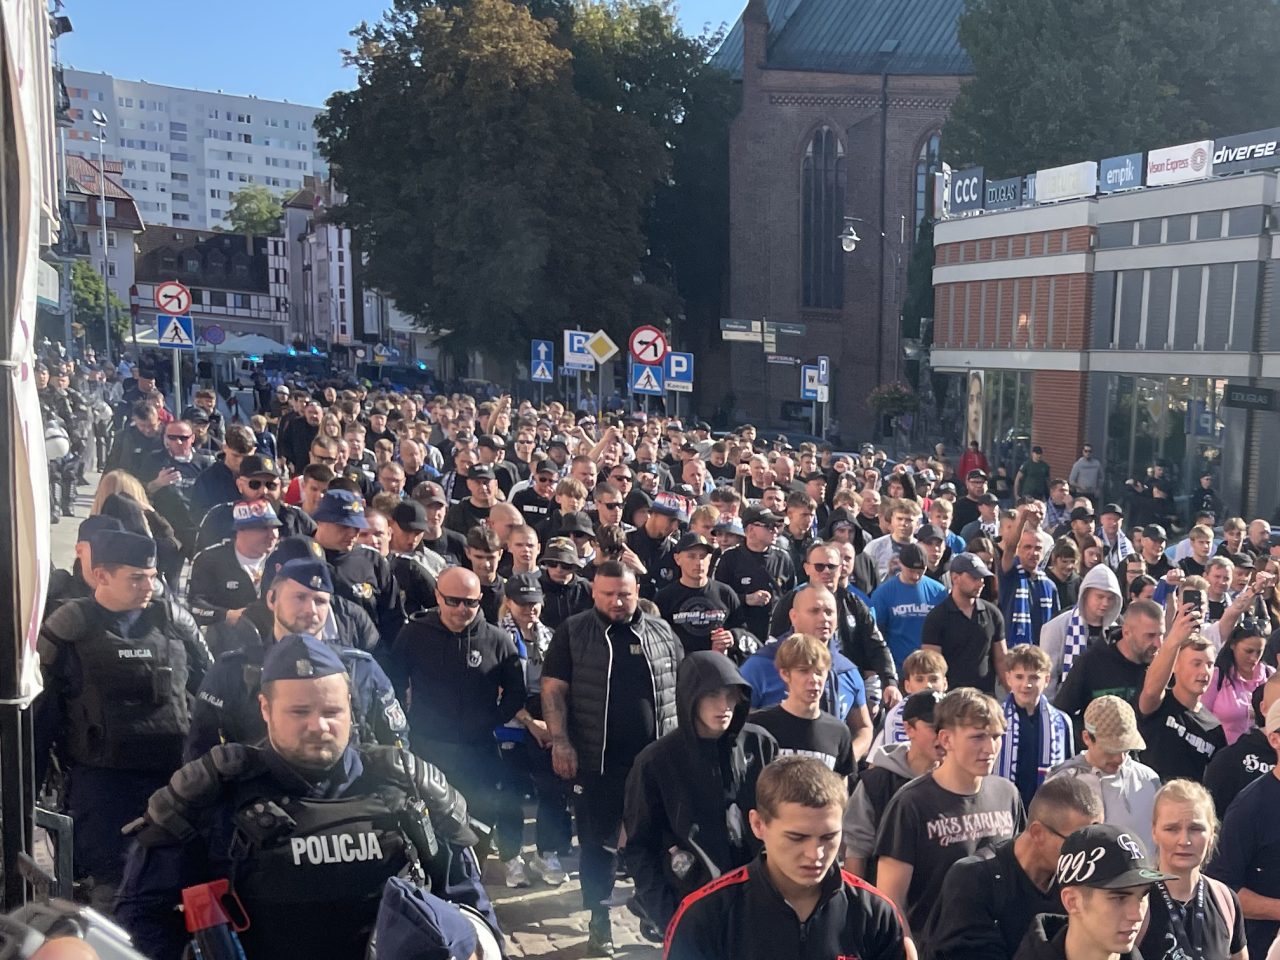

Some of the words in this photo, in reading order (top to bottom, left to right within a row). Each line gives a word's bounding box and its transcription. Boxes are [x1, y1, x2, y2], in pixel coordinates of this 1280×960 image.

[1213, 141, 1277, 164] diverse
[1107, 158, 1135, 187] empik
[1166, 157, 1189, 173] Express
[955, 177, 978, 204] CCC
[559, 367, 577, 377] TAXI
[671, 356, 688, 377] P
[666, 382, 690, 391] Koniec
[118, 649, 152, 658] POLICJA
[927, 815, 961, 839] MKS
[291, 832, 383, 865] POLICJA
[1056, 847, 1106, 885] 1993
